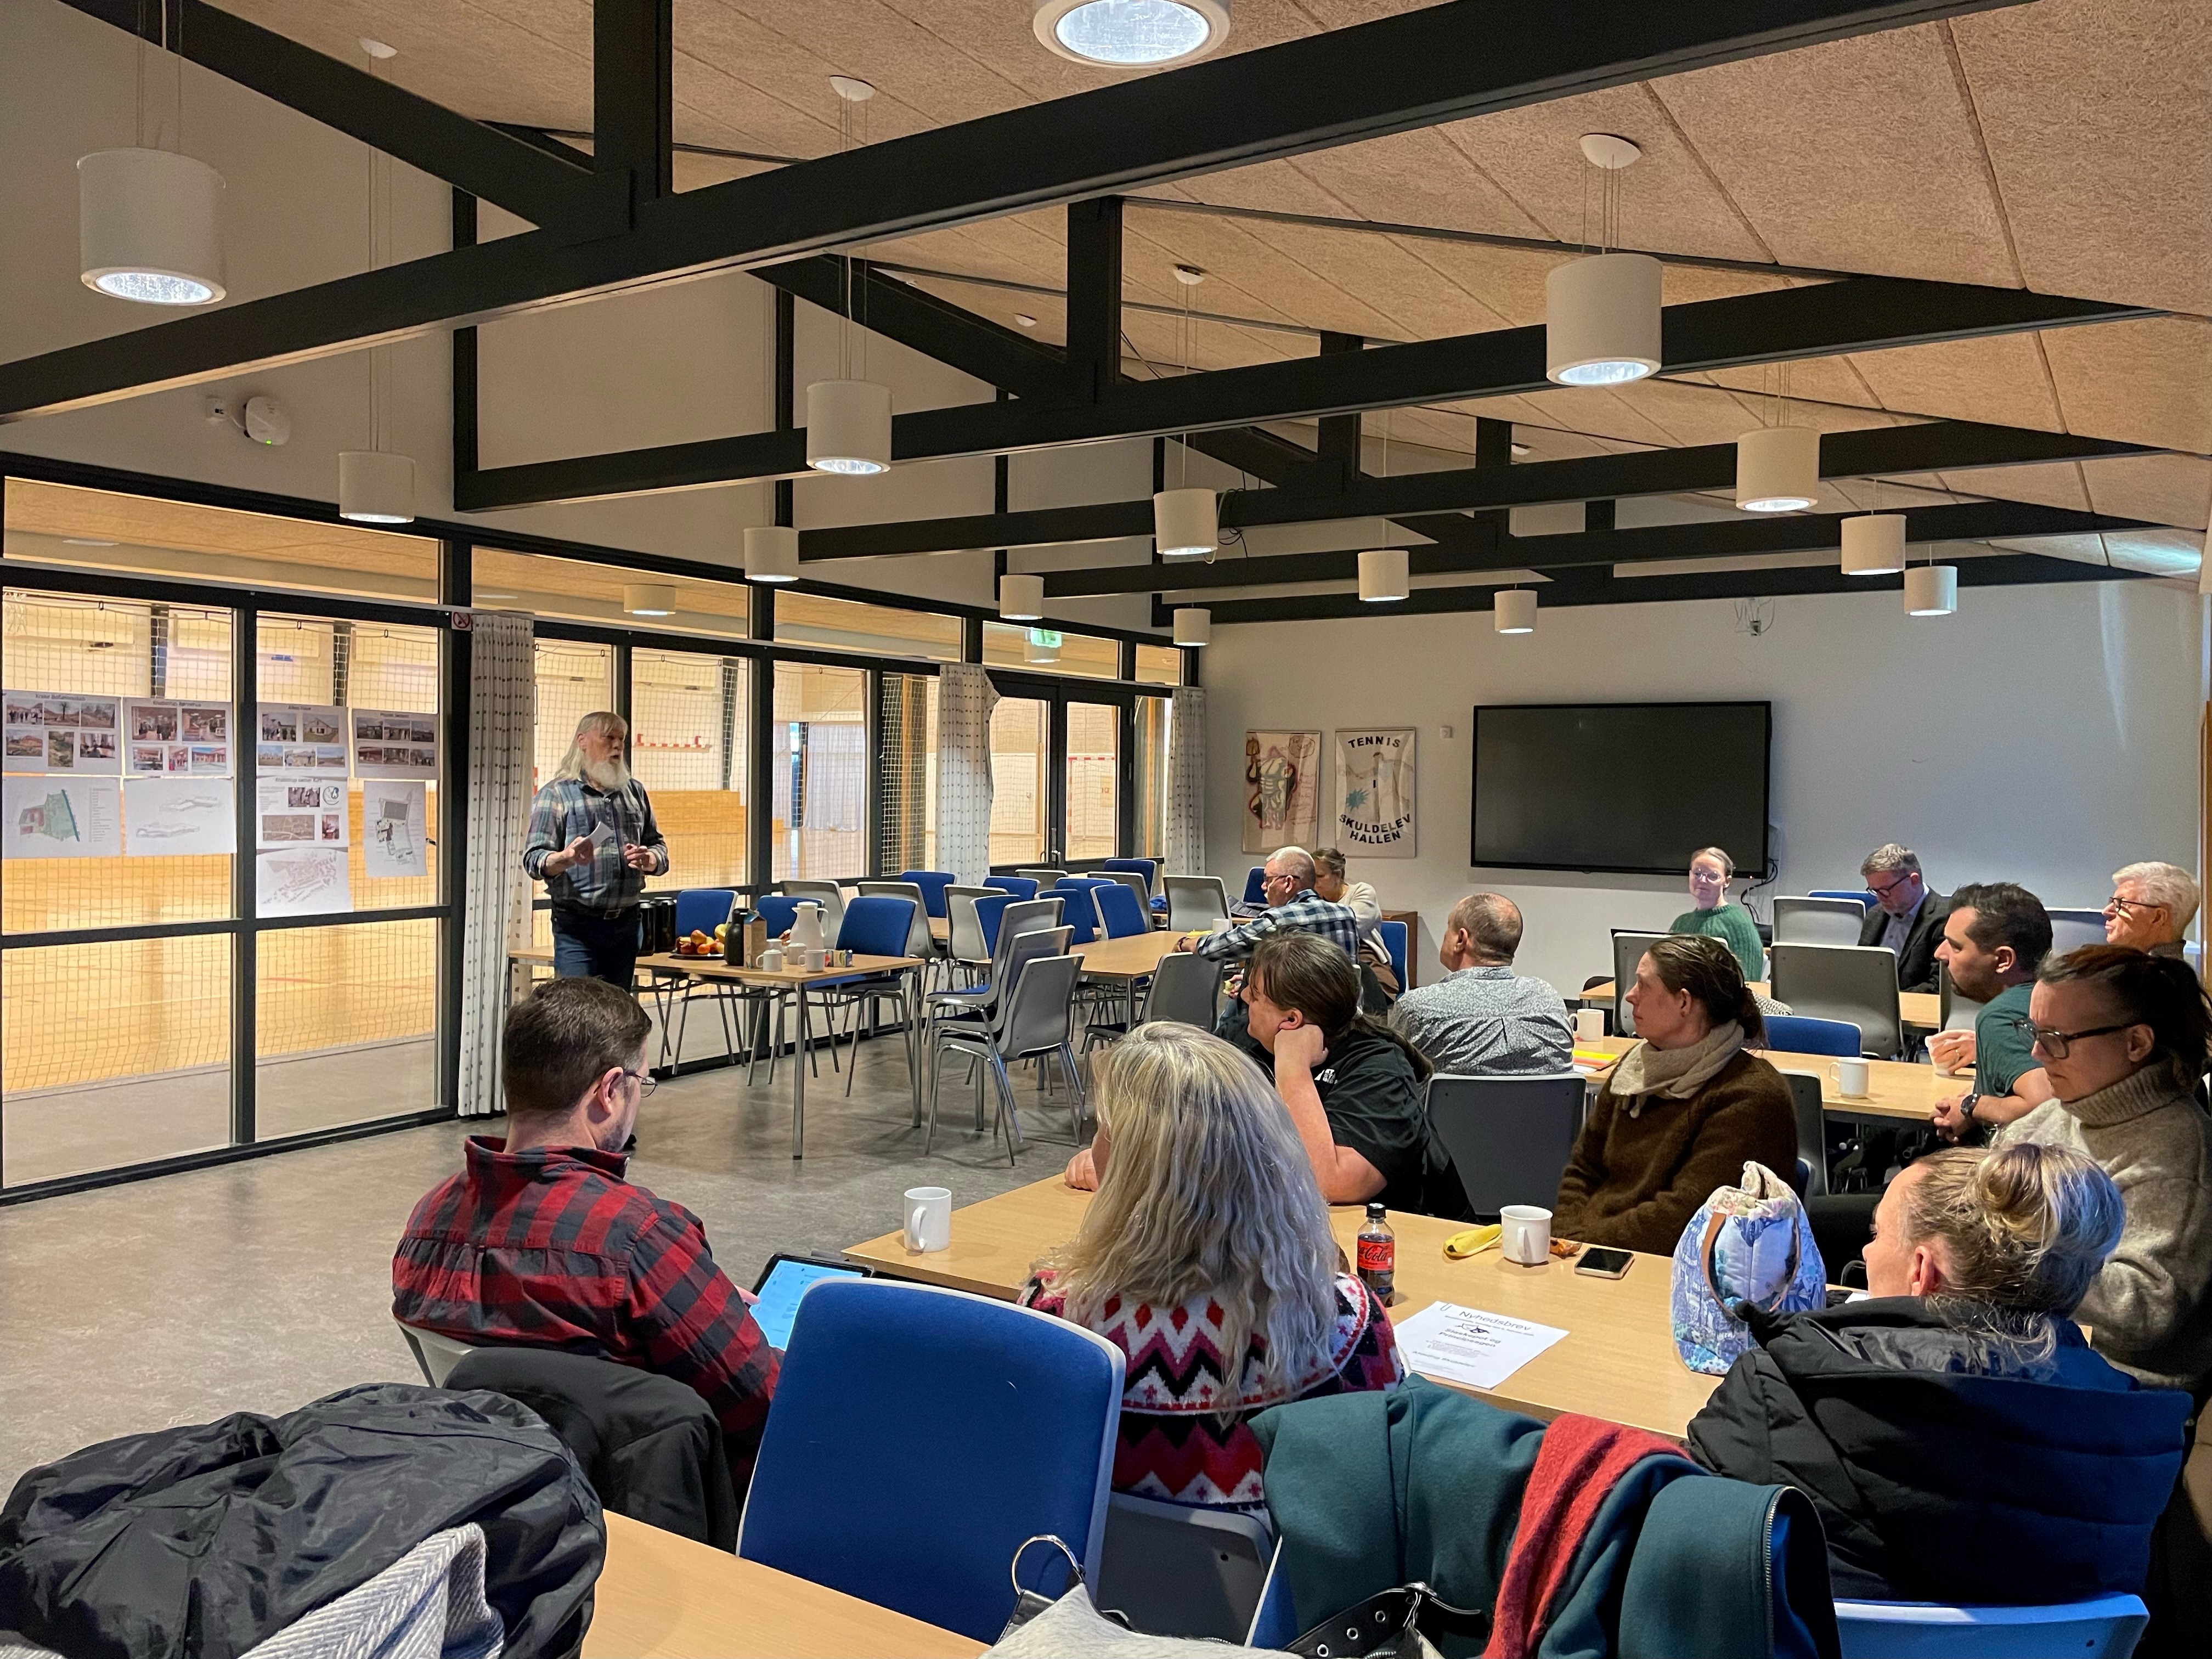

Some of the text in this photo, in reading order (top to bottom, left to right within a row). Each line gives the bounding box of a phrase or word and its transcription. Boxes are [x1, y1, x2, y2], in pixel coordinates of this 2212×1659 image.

[1348, 736, 1400, 748] TENNIS
[1373, 780, 1376, 788] I
[1339, 814, 1410, 833] SKULDELEV
[1350, 831, 1401, 844] HALLEN
[1459, 1311, 1531, 1331] Nyhedsbrev
